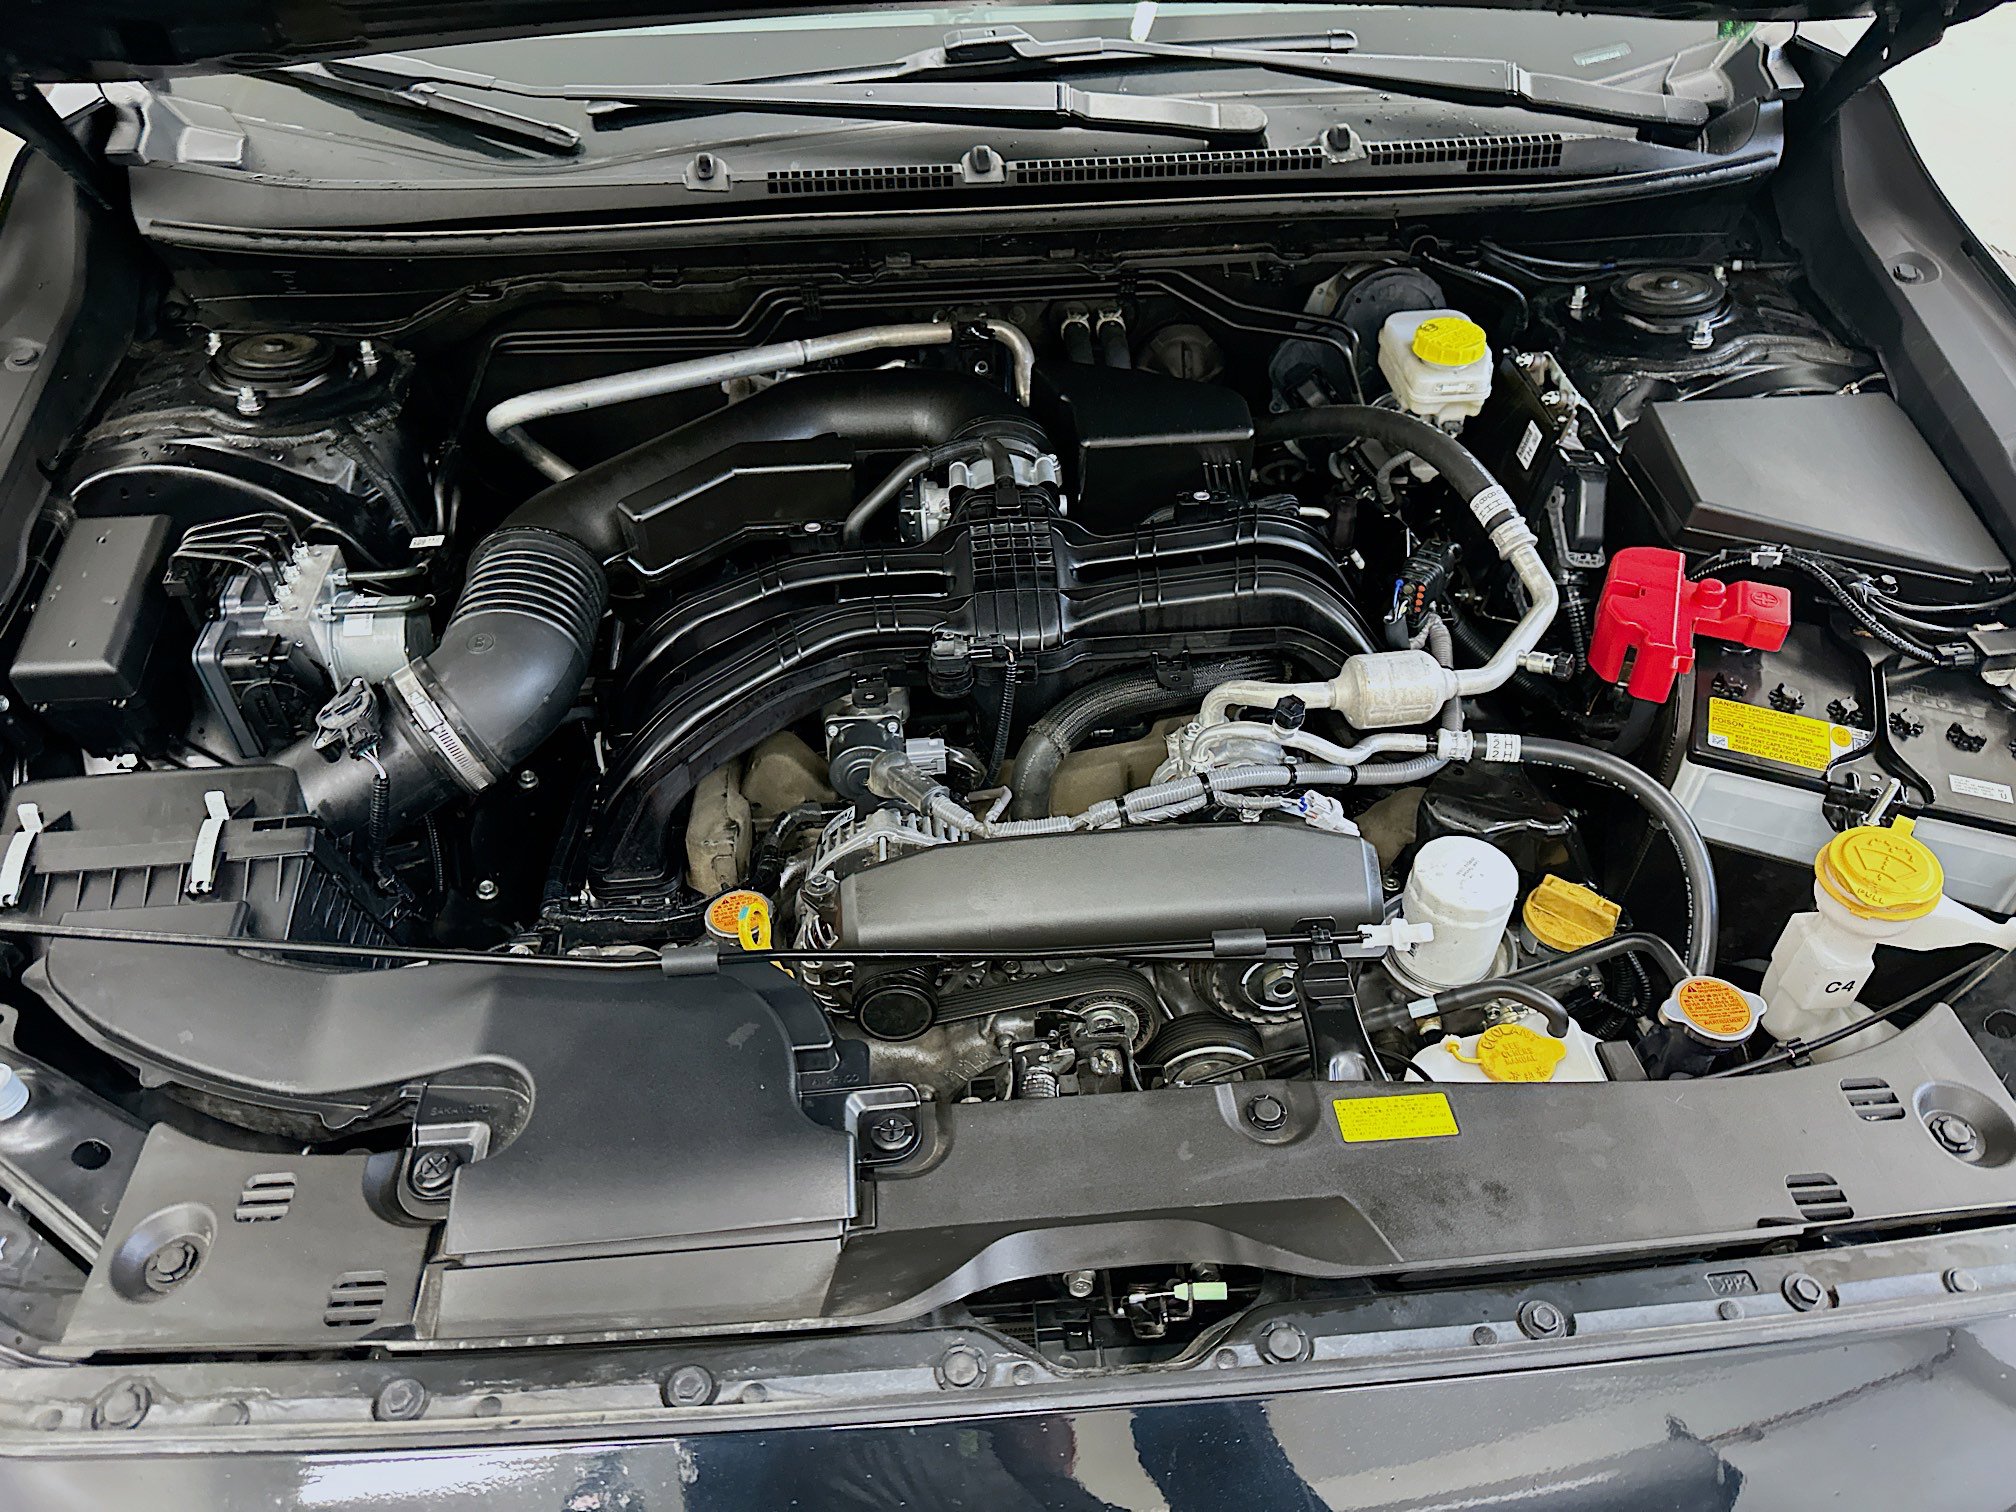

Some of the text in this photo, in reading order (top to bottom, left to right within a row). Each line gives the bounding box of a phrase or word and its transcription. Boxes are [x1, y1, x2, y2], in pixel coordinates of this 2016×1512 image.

[1712, 699, 1746, 710] DANGER
[1748, 707, 1778, 718] EXPLOSIVE
[1779, 713, 1798, 722] GASES
[1712, 717, 1744, 727] POISON
[1749, 725, 1771, 734] CAUSES
[1772, 730, 1793, 739] SEVERE
[1731, 743, 1749, 752] 20HR
[1749, 747, 1766, 756] 62Ah
[1769, 752, 1784, 760] CCA
[1772, 747, 1792, 756] REACH
[1801, 754, 1828, 764] CHILDREN
[1857, 888, 1885, 904] PULL
[1824, 980, 1856, 994] C4
[1481, 1026, 1540, 1050] COOLANT
[1502, 1042, 1520, 1051] SEE
